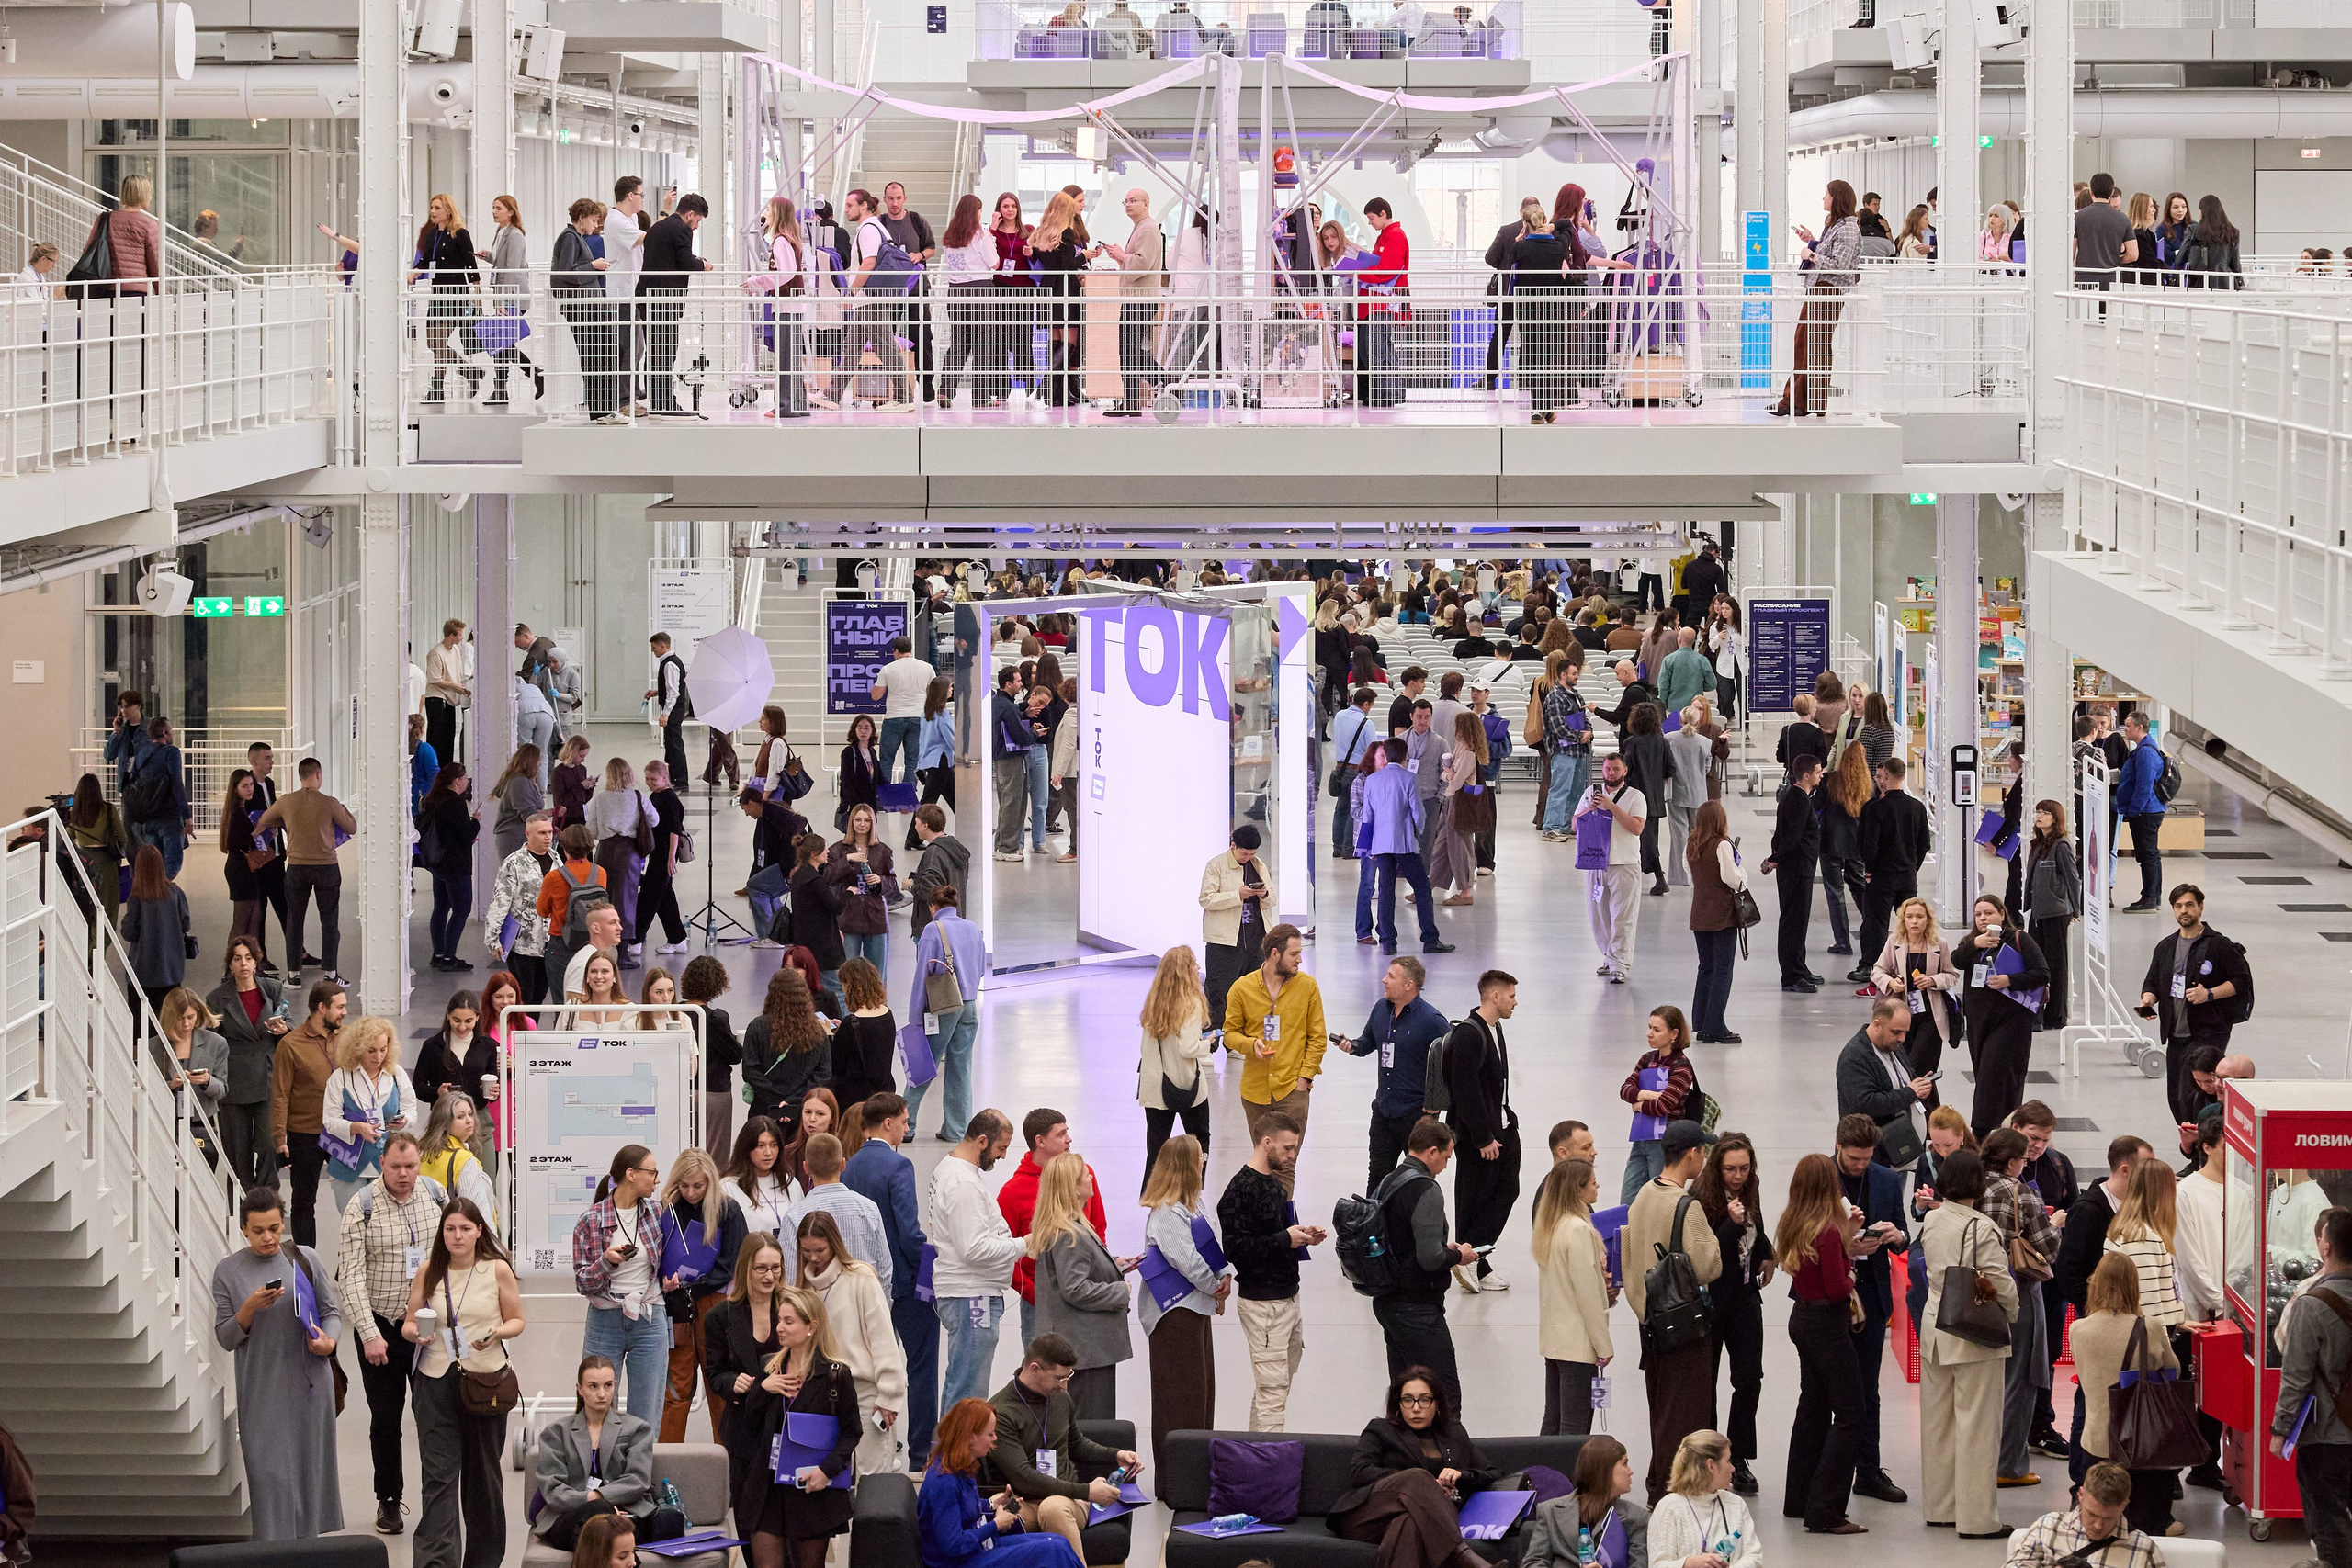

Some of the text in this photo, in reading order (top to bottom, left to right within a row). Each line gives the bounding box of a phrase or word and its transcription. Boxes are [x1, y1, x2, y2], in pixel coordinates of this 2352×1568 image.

[830, 615, 904, 631] ГЛАВ
[828, 663, 884, 678] ПРО
[1080, 606, 1230, 722] ТОК
[830, 679, 876, 693] ПЕ
[1263, 1015, 1275, 1041] ТОК
[1655, 1068, 1669, 1140] ТК
[2294, 1134, 2352, 1147] ЛОВИМ
[319, 1139, 359, 1169] ТОК
[1171, 1292, 1183, 1301] ТОК
[969, 1296, 983, 1328] ТОК
[1591, 1377, 1605, 1409] ТОК
[1036, 1449, 1051, 1473] ТО
[1460, 1525, 1508, 1540] ОК
